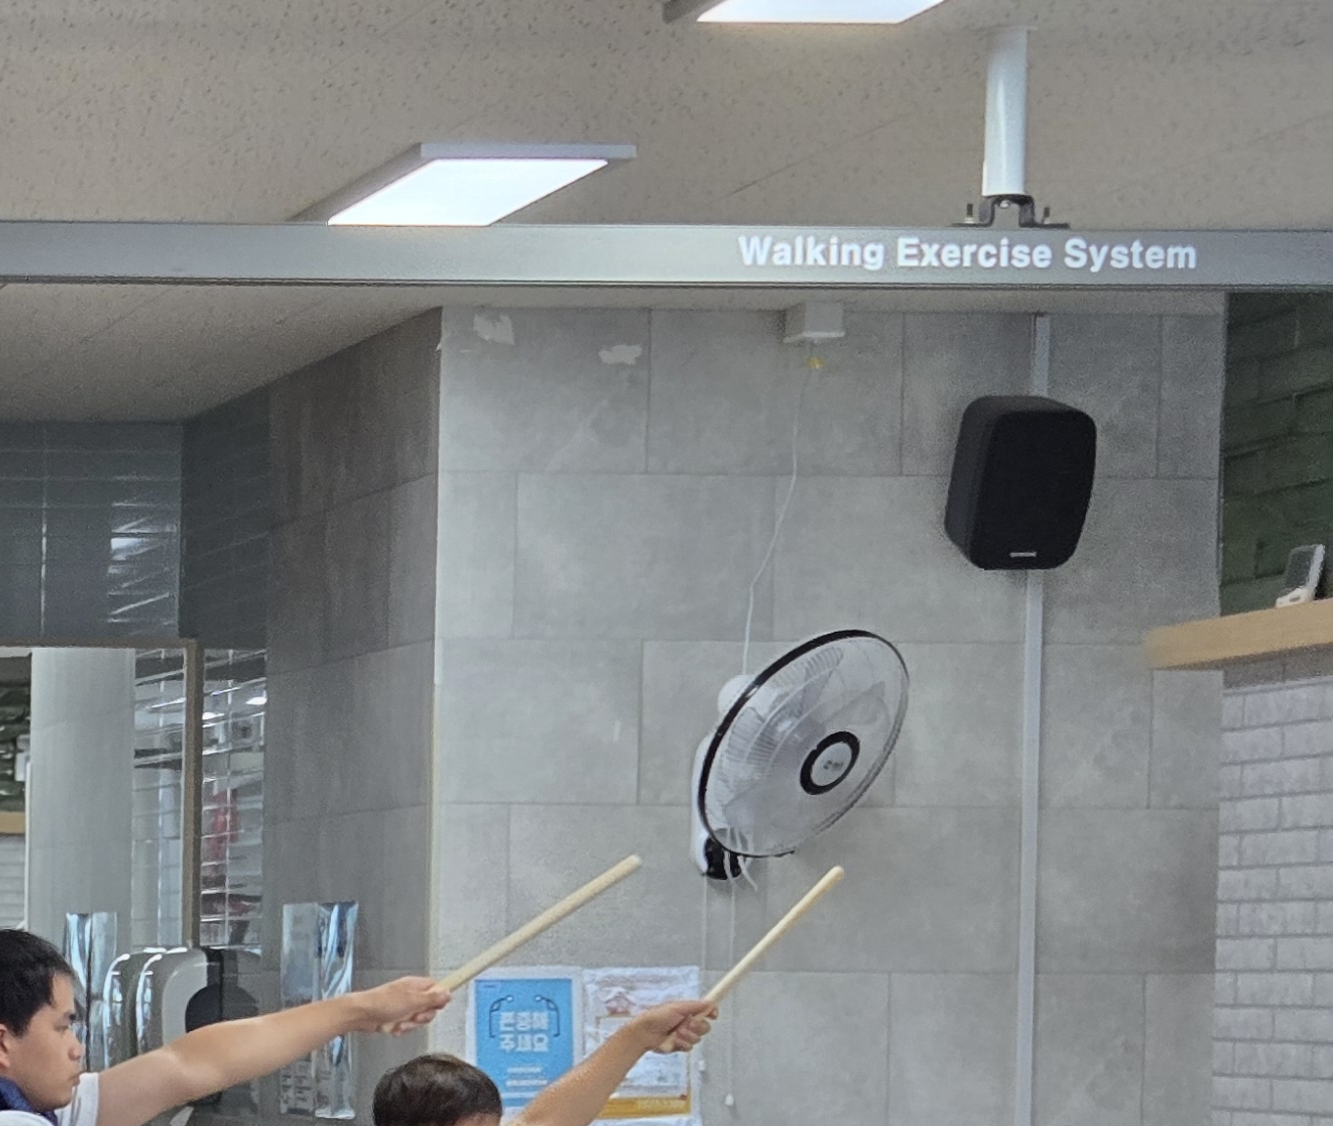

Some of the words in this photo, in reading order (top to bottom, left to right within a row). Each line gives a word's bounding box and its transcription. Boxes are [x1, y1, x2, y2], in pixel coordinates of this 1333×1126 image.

[738, 236, 884, 269] Walking
[897, 237, 1052, 268] Exercise
[1064, 238, 1197, 272] System
